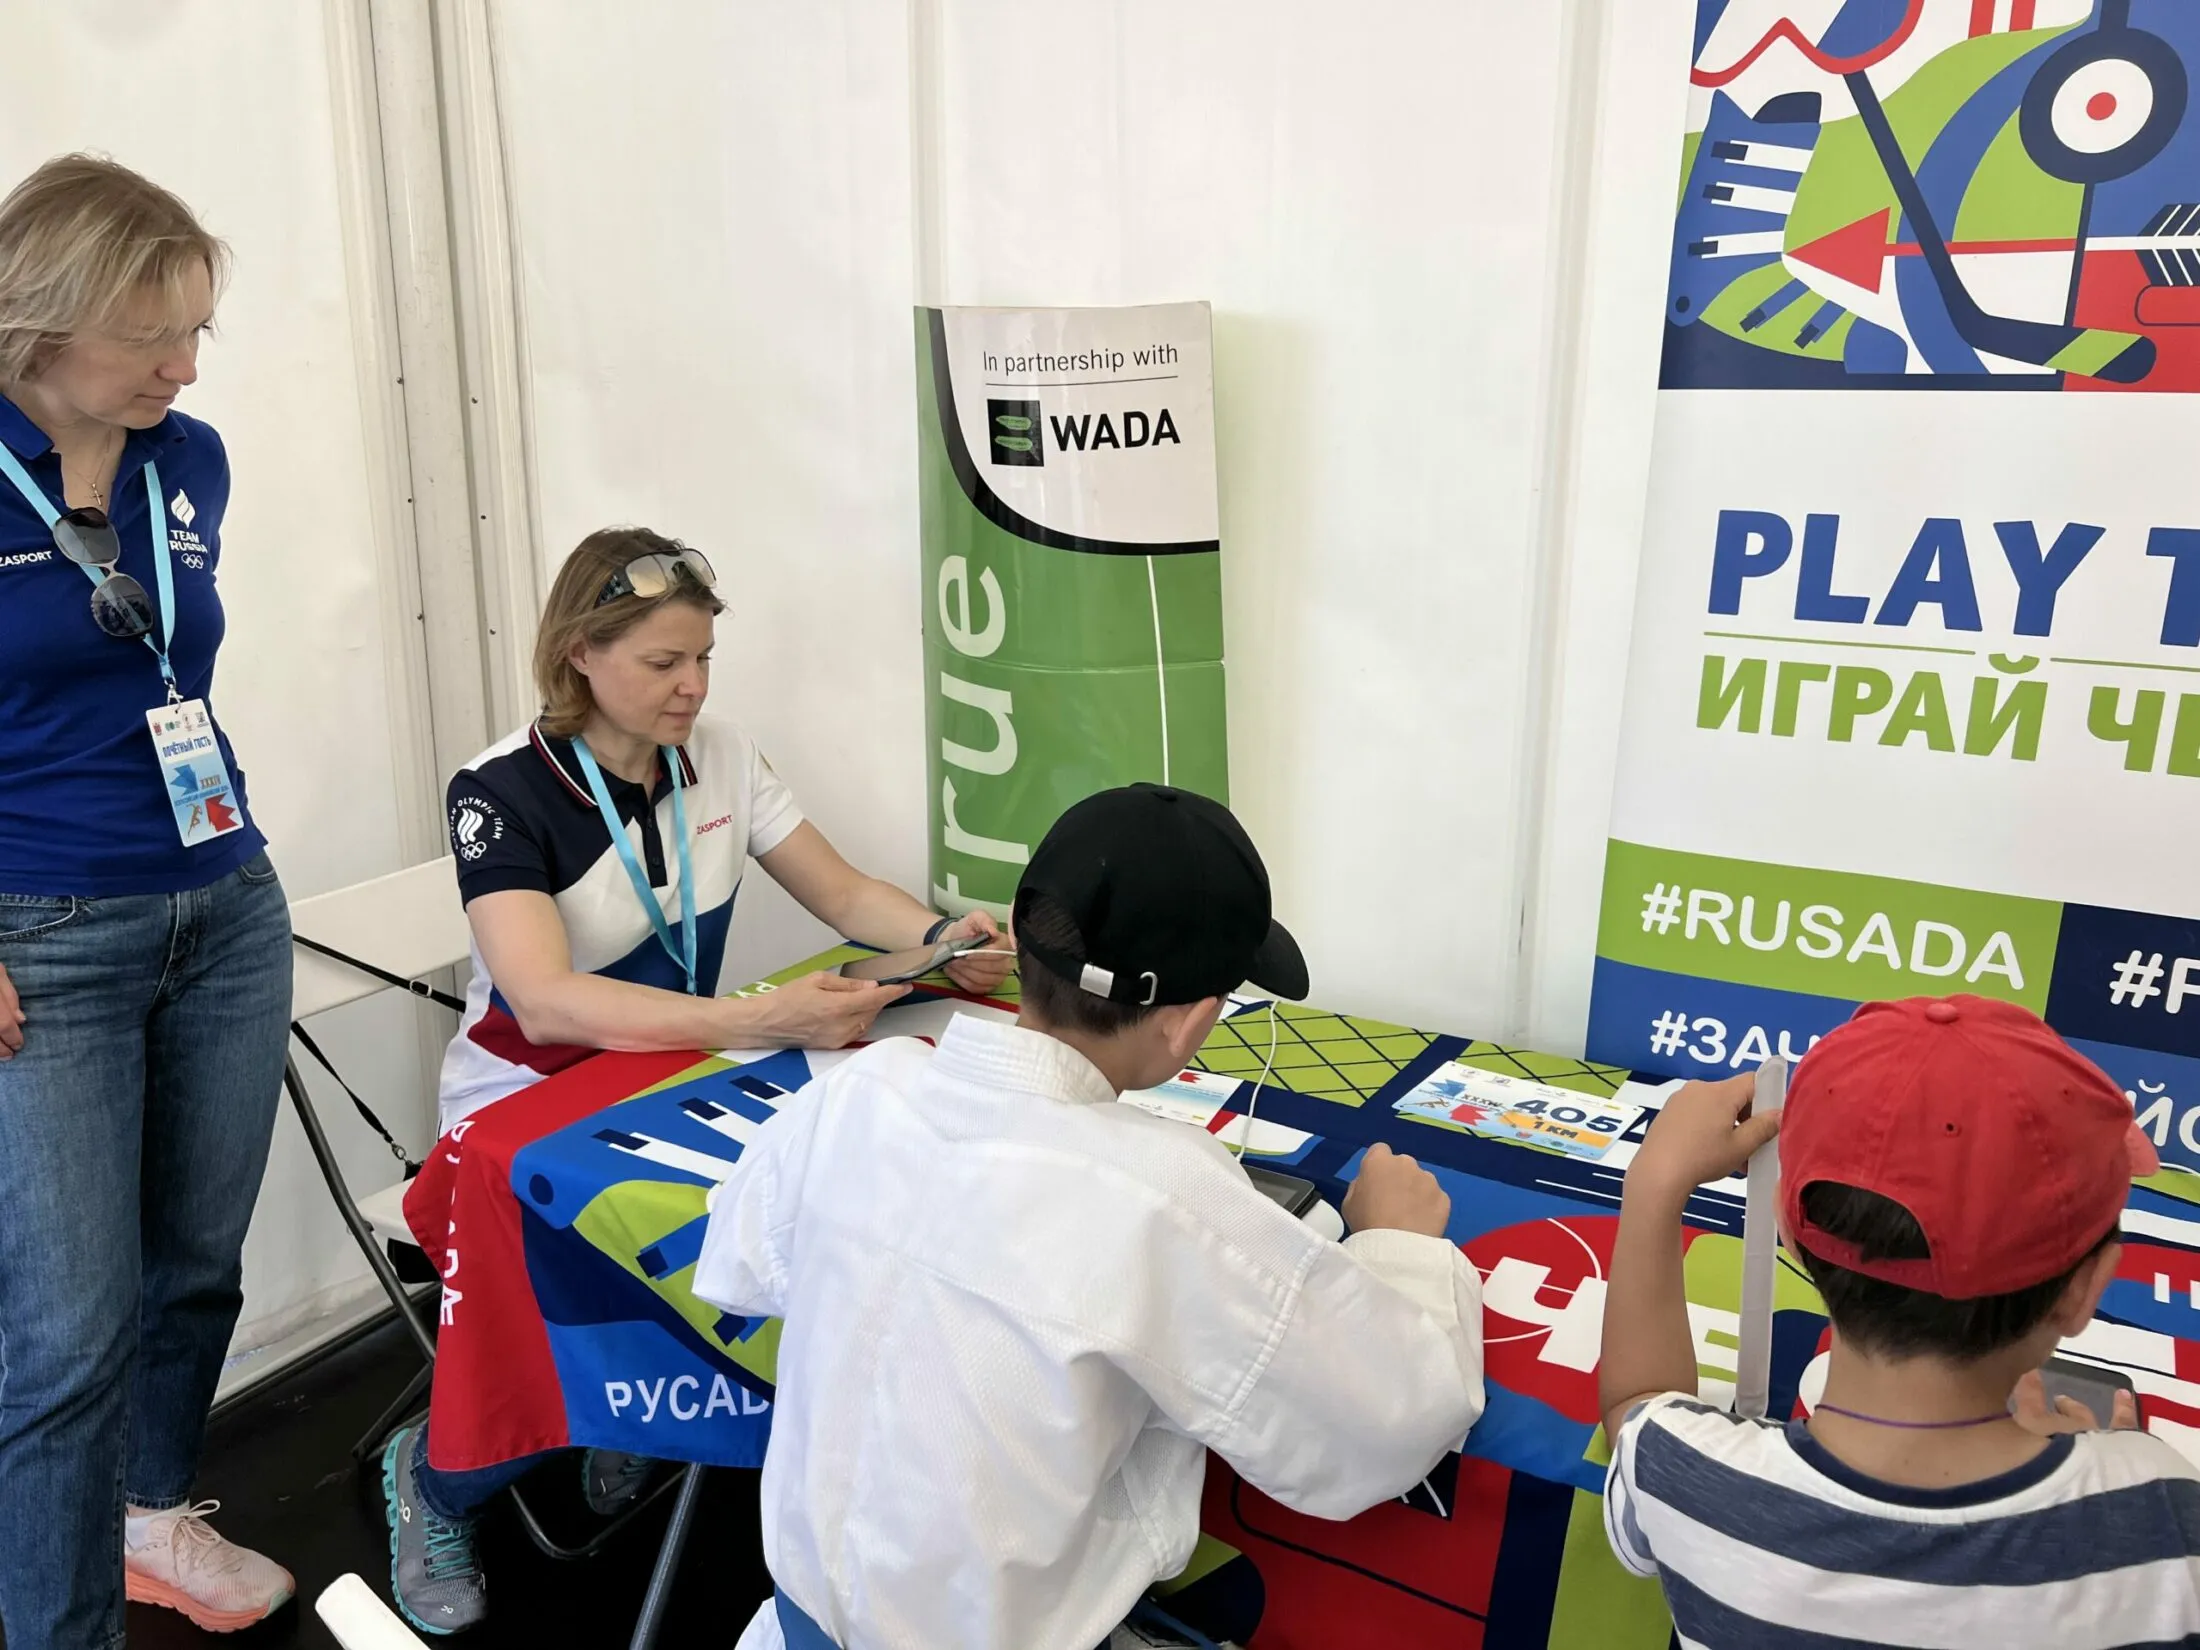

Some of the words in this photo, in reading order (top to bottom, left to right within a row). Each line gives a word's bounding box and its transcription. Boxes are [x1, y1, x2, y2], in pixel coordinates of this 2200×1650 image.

[983, 350, 998, 372] In
[1004, 348, 1125, 376] partnership
[1132, 343, 1179, 367] with
[1049, 408, 1181, 452] WADA
[169, 540, 208, 554] RUSSIA
[170, 529, 200, 544] TEAM
[1708, 509, 2107, 637] PLAY
[1696, 652, 2049, 762] ИГРАЙ
[457, 796, 496, 815] OLYMPIC
[492, 816, 504, 840] TEAM
[1641, 882, 2025, 990] #RUSADA
[1513, 1099, 1623, 1133] 405
